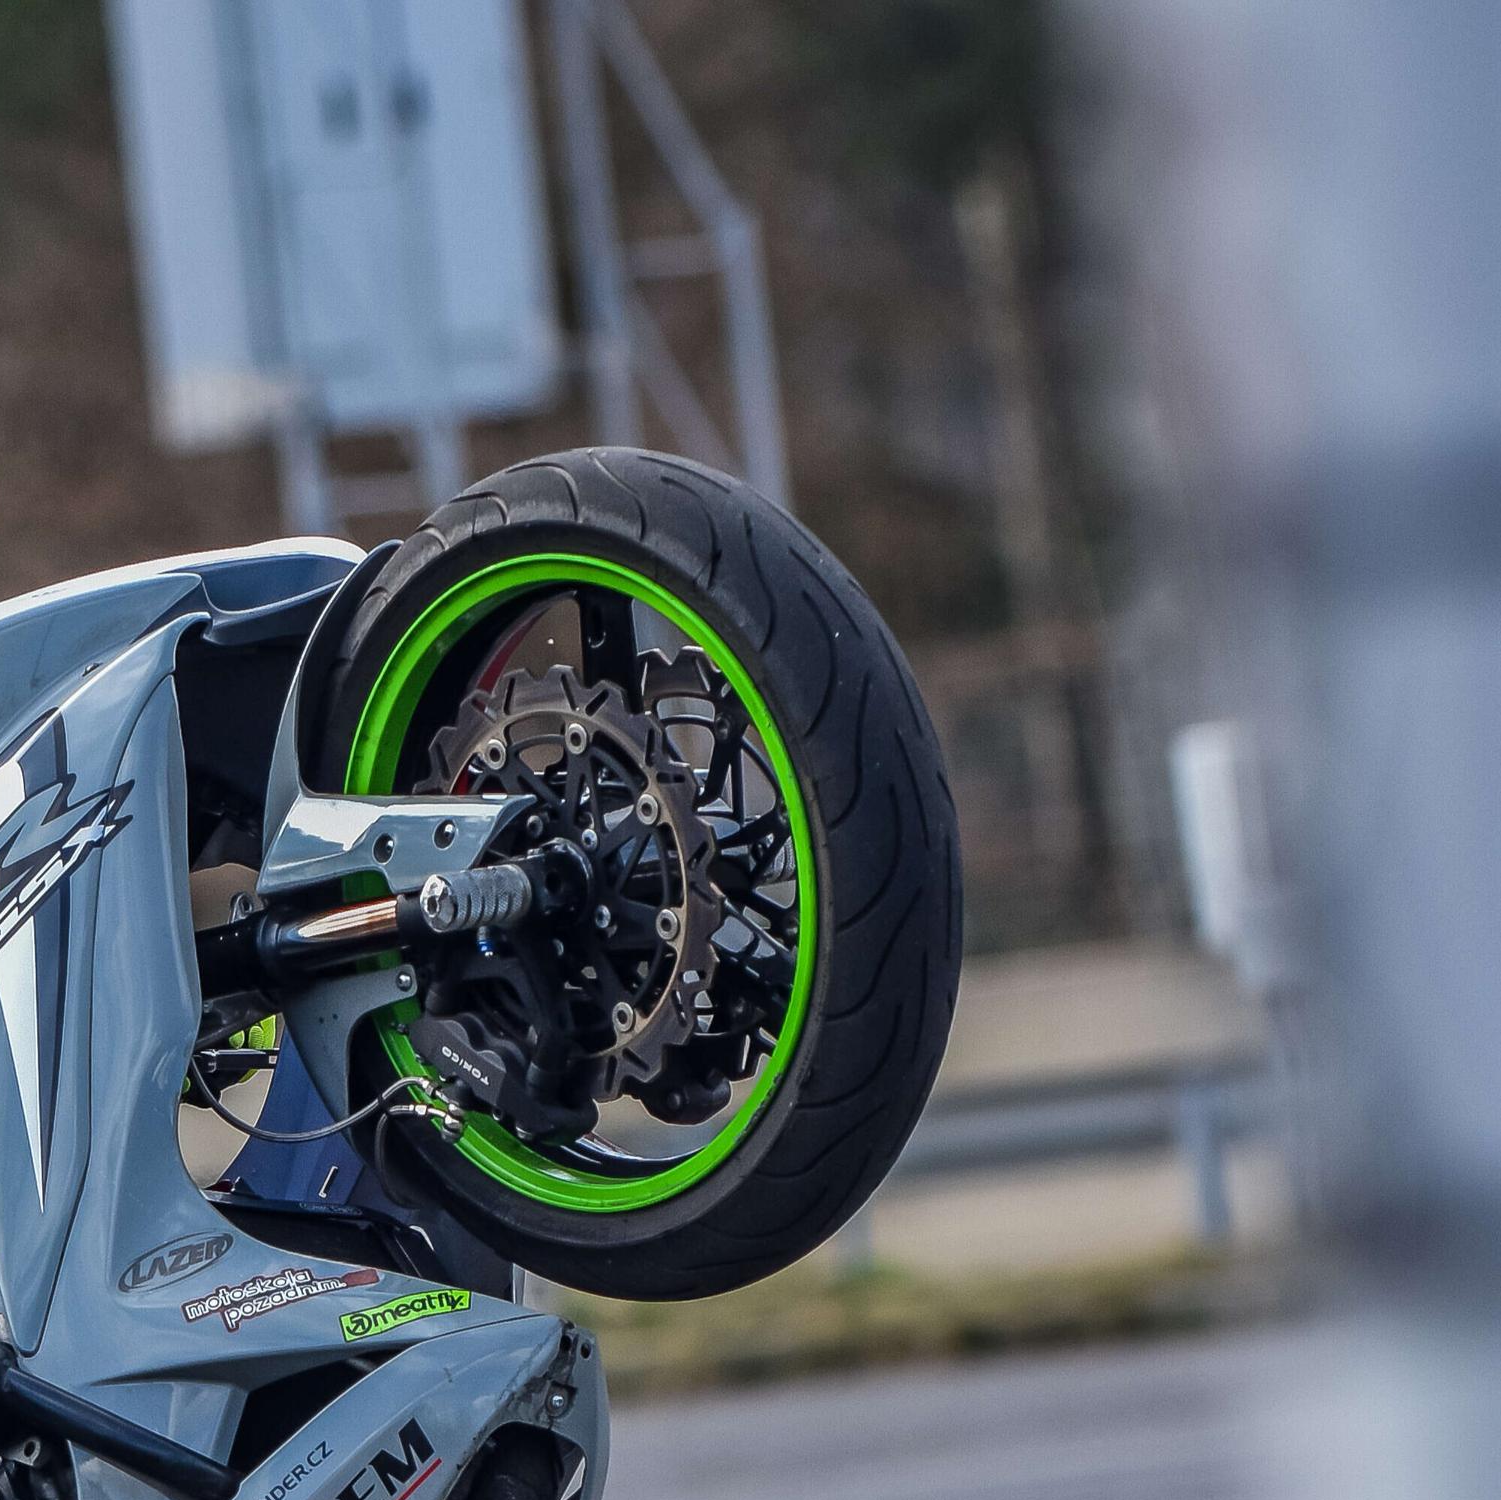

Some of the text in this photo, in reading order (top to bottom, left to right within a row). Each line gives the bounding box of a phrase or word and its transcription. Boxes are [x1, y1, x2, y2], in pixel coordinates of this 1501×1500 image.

[441, 1045, 491, 1087] TOKICO
[132, 1236, 226, 1283] LAZER
[185, 1269, 311, 1319] motoskola
